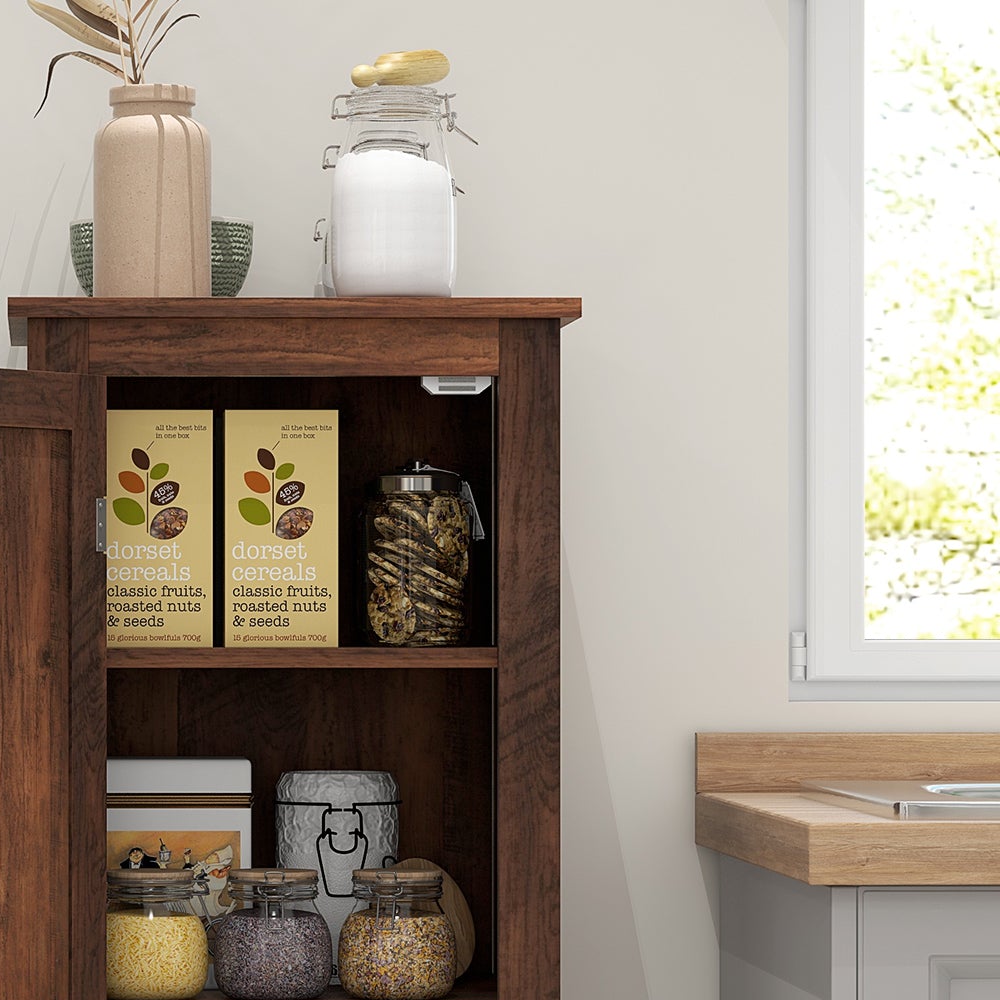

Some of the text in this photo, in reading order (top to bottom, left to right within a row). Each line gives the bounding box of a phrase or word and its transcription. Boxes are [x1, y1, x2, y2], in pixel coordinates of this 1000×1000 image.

[106, 541, 182, 560] dorset
[232, 541, 307, 560] dorset
[106, 563, 191, 581] cereals
[232, 563, 317, 581] cereals
[107, 585, 206, 599] classic fruits,
[232, 585, 332, 599] classic fruits,
[107, 600, 201, 612] roasted nuts
[232, 600, 327, 612] roasted nuts
[107, 615, 164, 627] & seeds
[232, 615, 290, 627] & seeds
[117, 634, 148, 642] glorious
[182, 634, 201, 642] 700g
[242, 634, 273, 642] glorious
[308, 634, 327, 642] 700g
